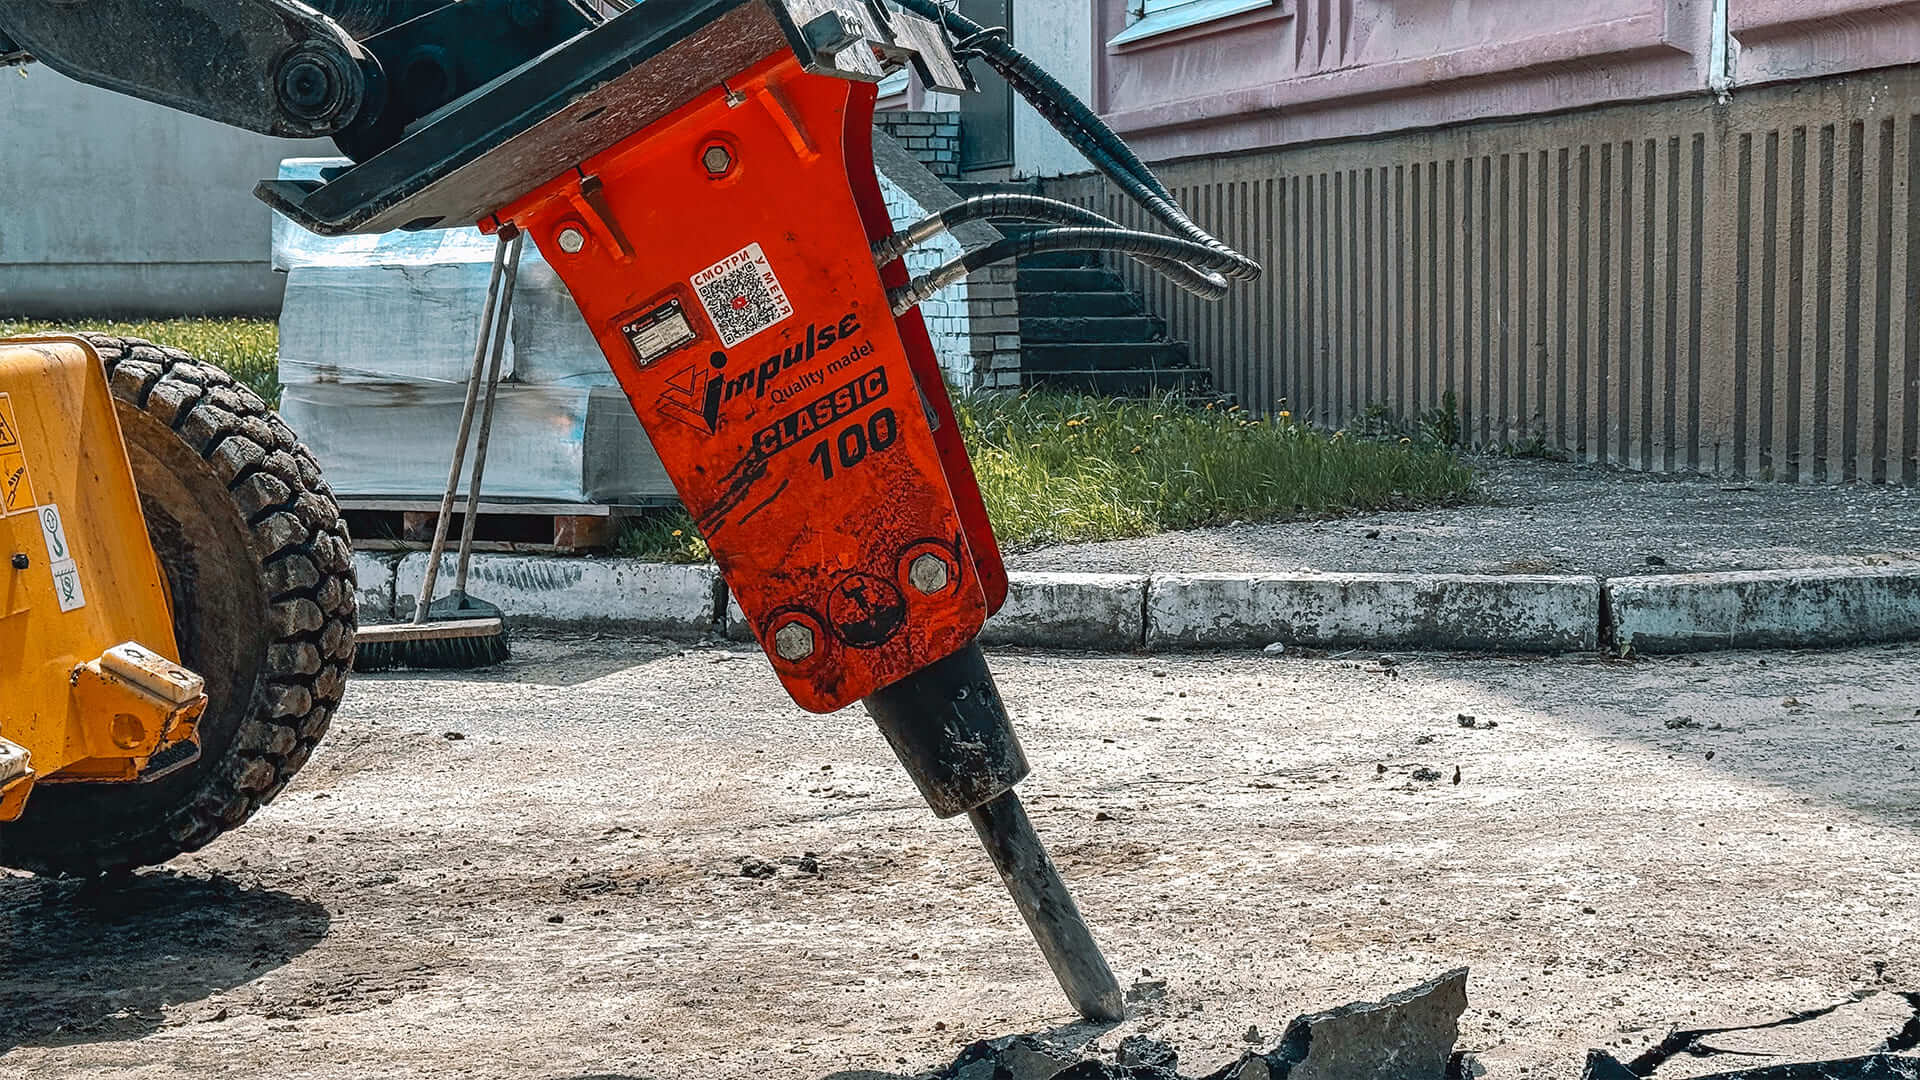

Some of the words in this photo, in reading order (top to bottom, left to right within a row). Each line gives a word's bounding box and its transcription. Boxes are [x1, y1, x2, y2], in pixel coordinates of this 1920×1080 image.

[694, 250, 751, 286] СМОТРИ
[762, 271, 791, 315] МЕНЯ
[702, 312, 861, 435] impulse
[771, 370, 825, 404] Quality
[827, 340, 875, 375] made!
[758, 371, 884, 452] CLASSIC
[809, 407, 897, 481] 100
